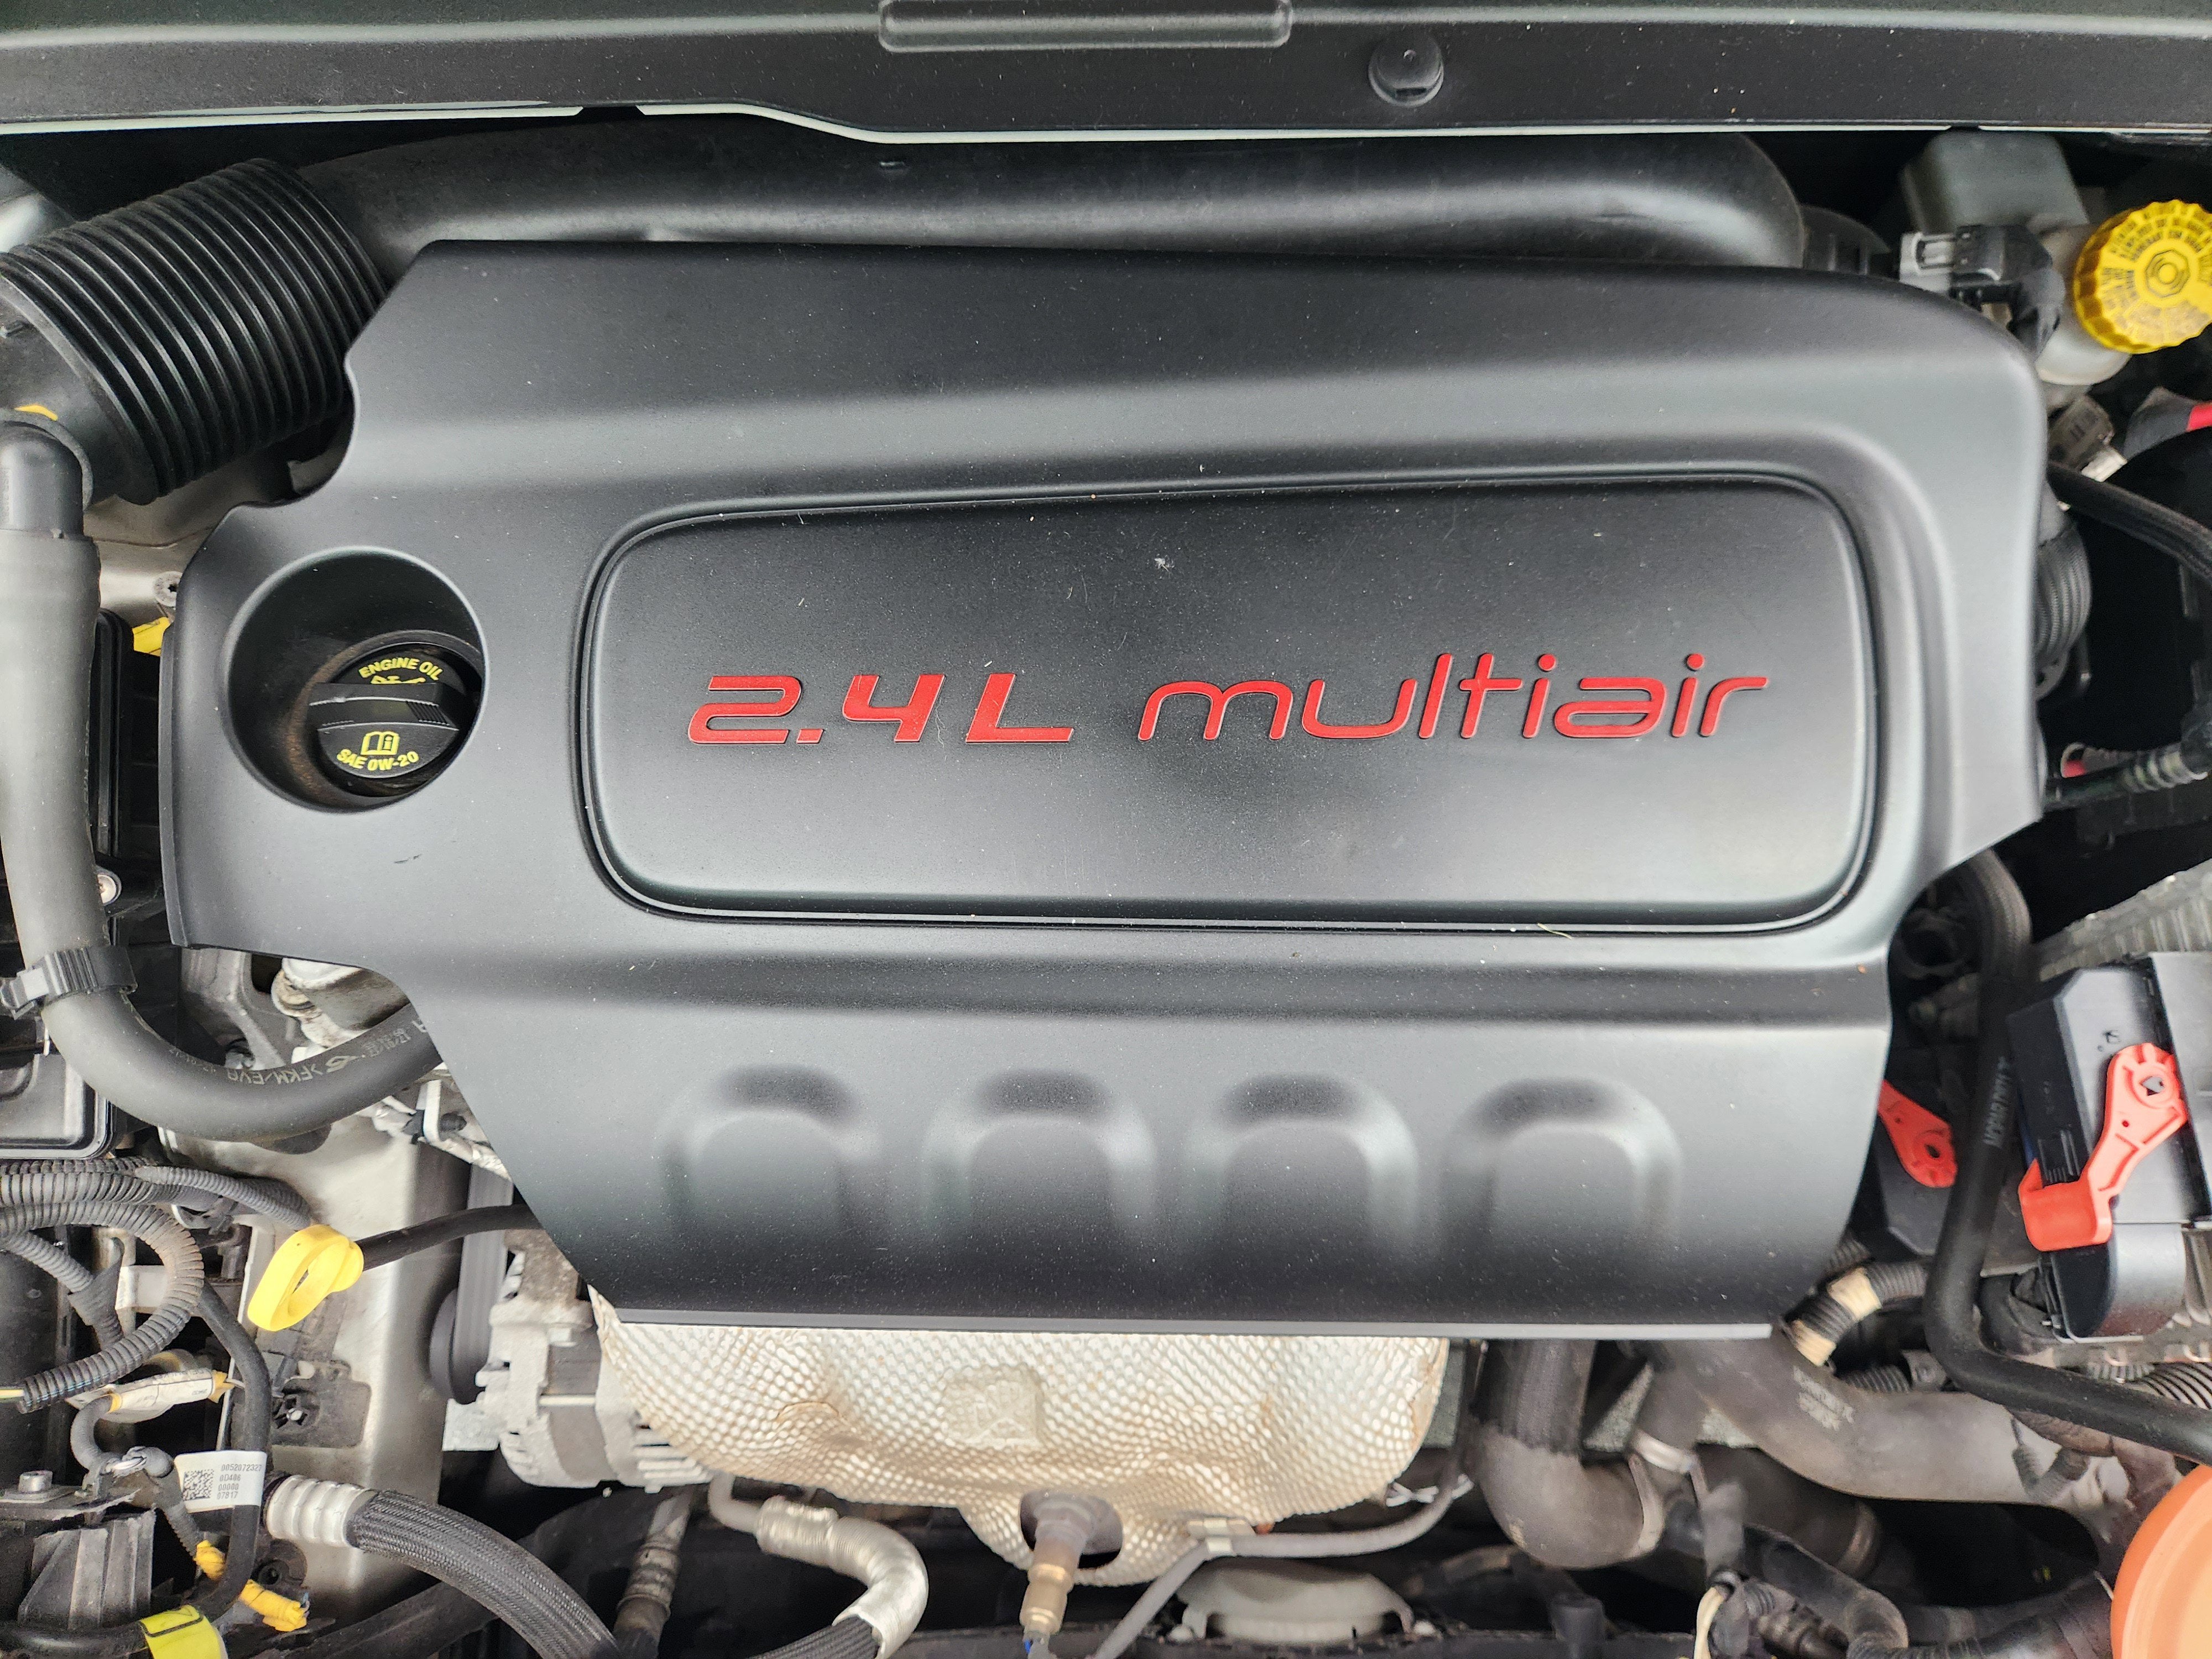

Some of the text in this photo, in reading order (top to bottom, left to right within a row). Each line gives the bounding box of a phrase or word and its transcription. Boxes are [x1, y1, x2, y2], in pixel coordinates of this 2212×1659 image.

[359, 657, 443, 681] ENGINE OIL
[1138, 653, 1768, 741] multiair
[337, 749, 419, 771] SAE 0W-20
